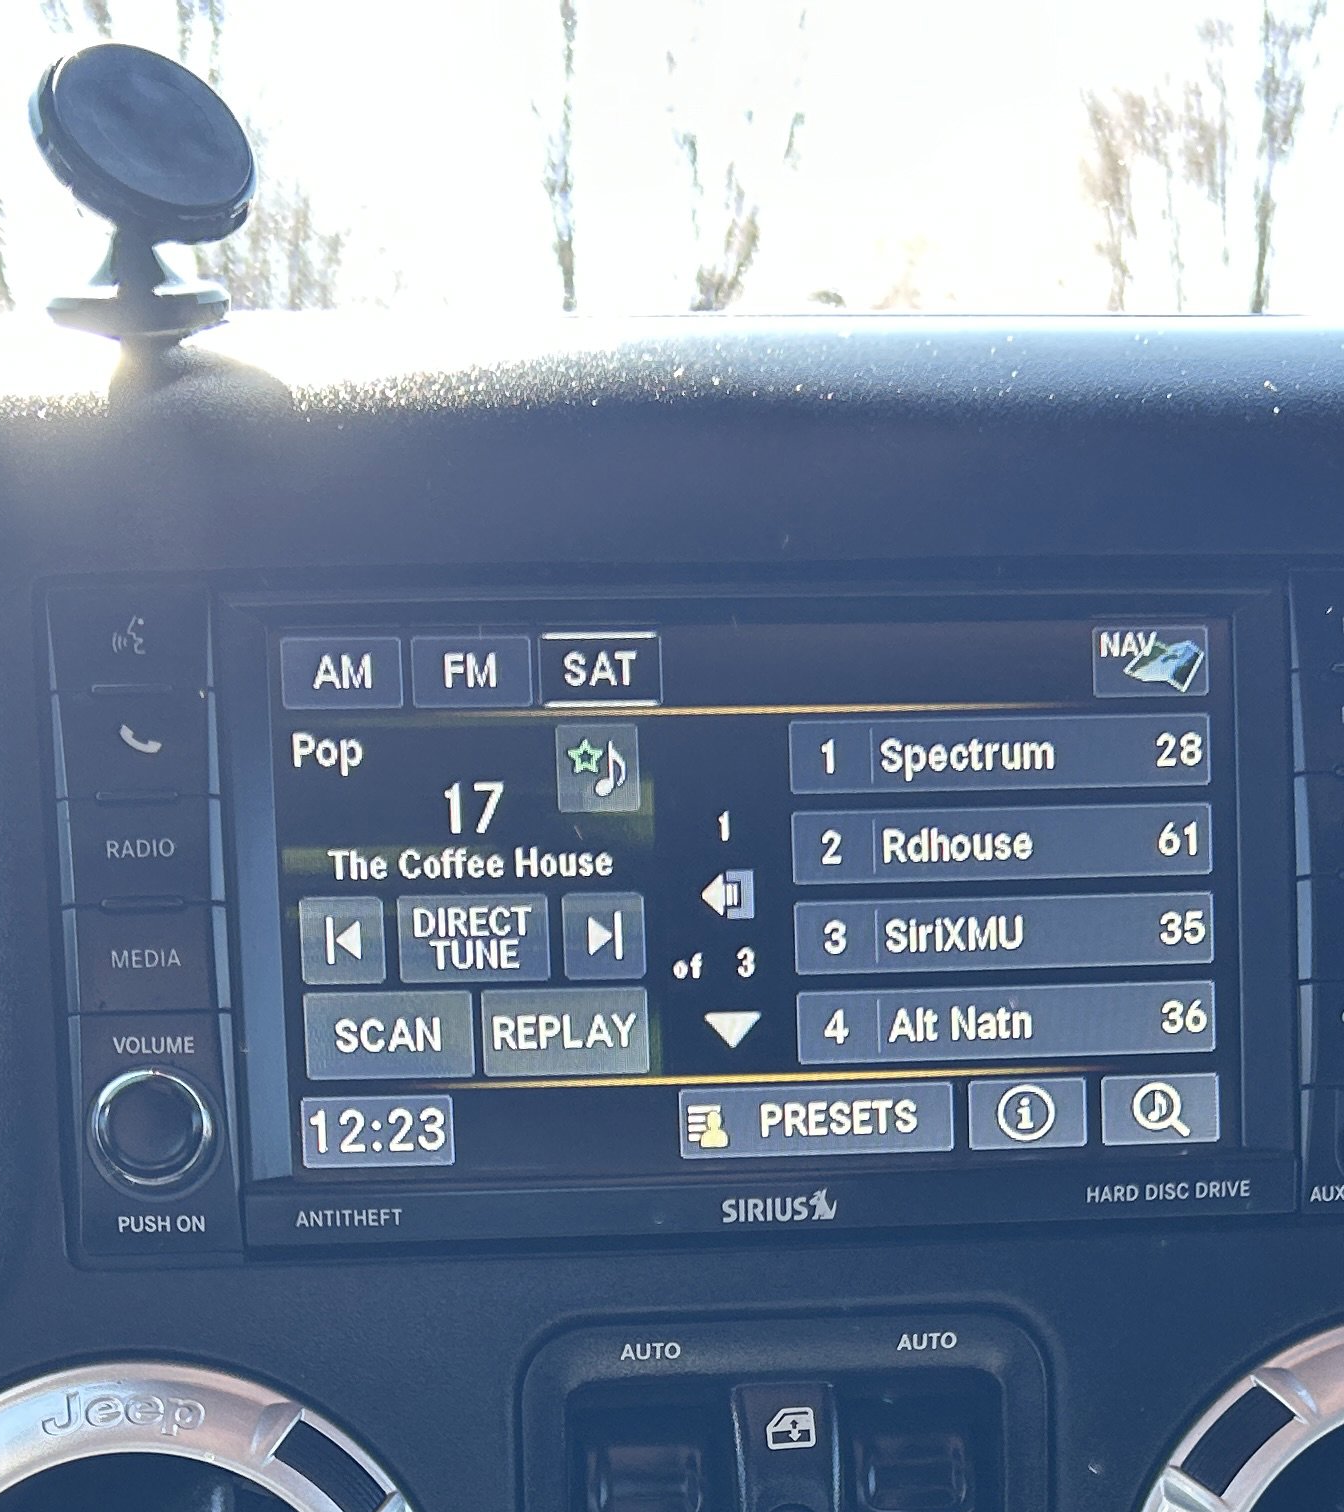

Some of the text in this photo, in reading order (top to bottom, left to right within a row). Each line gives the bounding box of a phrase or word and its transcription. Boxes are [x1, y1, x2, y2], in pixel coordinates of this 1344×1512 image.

[1100, 631, 1158, 658] NAV
[312, 653, 373, 690] AM
[443, 652, 497, 688] FM
[563, 650, 637, 687] SAT
[292, 732, 363, 776] Pop
[821, 732, 1202, 782] 1 Spectrum 28
[444, 781, 504, 835] 17
[718, 810, 730, 842] 1
[106, 838, 175, 859] RADIO
[821, 821, 1198, 866] 2 Rdhouse 61
[328, 844, 613, 881] The Coffee House
[413, 906, 532, 938] DIRECT
[823, 910, 1206, 956] 3 SiriXMU 35
[111, 948, 182, 969] MEDIA
[429, 939, 521, 971] TUNE
[673, 946, 756, 980] of 3
[336, 1017, 442, 1053] SCAN
[493, 1013, 637, 1050] REPLAY
[823, 999, 1207, 1045] 4 Alt Natn 36
[112, 1036, 195, 1054] VOLUME
[309, 1106, 447, 1154] 12:23
[760, 1098, 918, 1138] PRESETS
[722, 1195, 810, 1224] SIRIUS
[1086, 1179, 1250, 1205] HARD DISC DRIVE
[118, 1215, 206, 1232] PUSH ON
[296, 1208, 403, 1228] ANTITHEFT
[620, 1342, 681, 1362] AUTO
[896, 1332, 957, 1352] AUTO
[41, 1390, 206, 1437] Jeep
